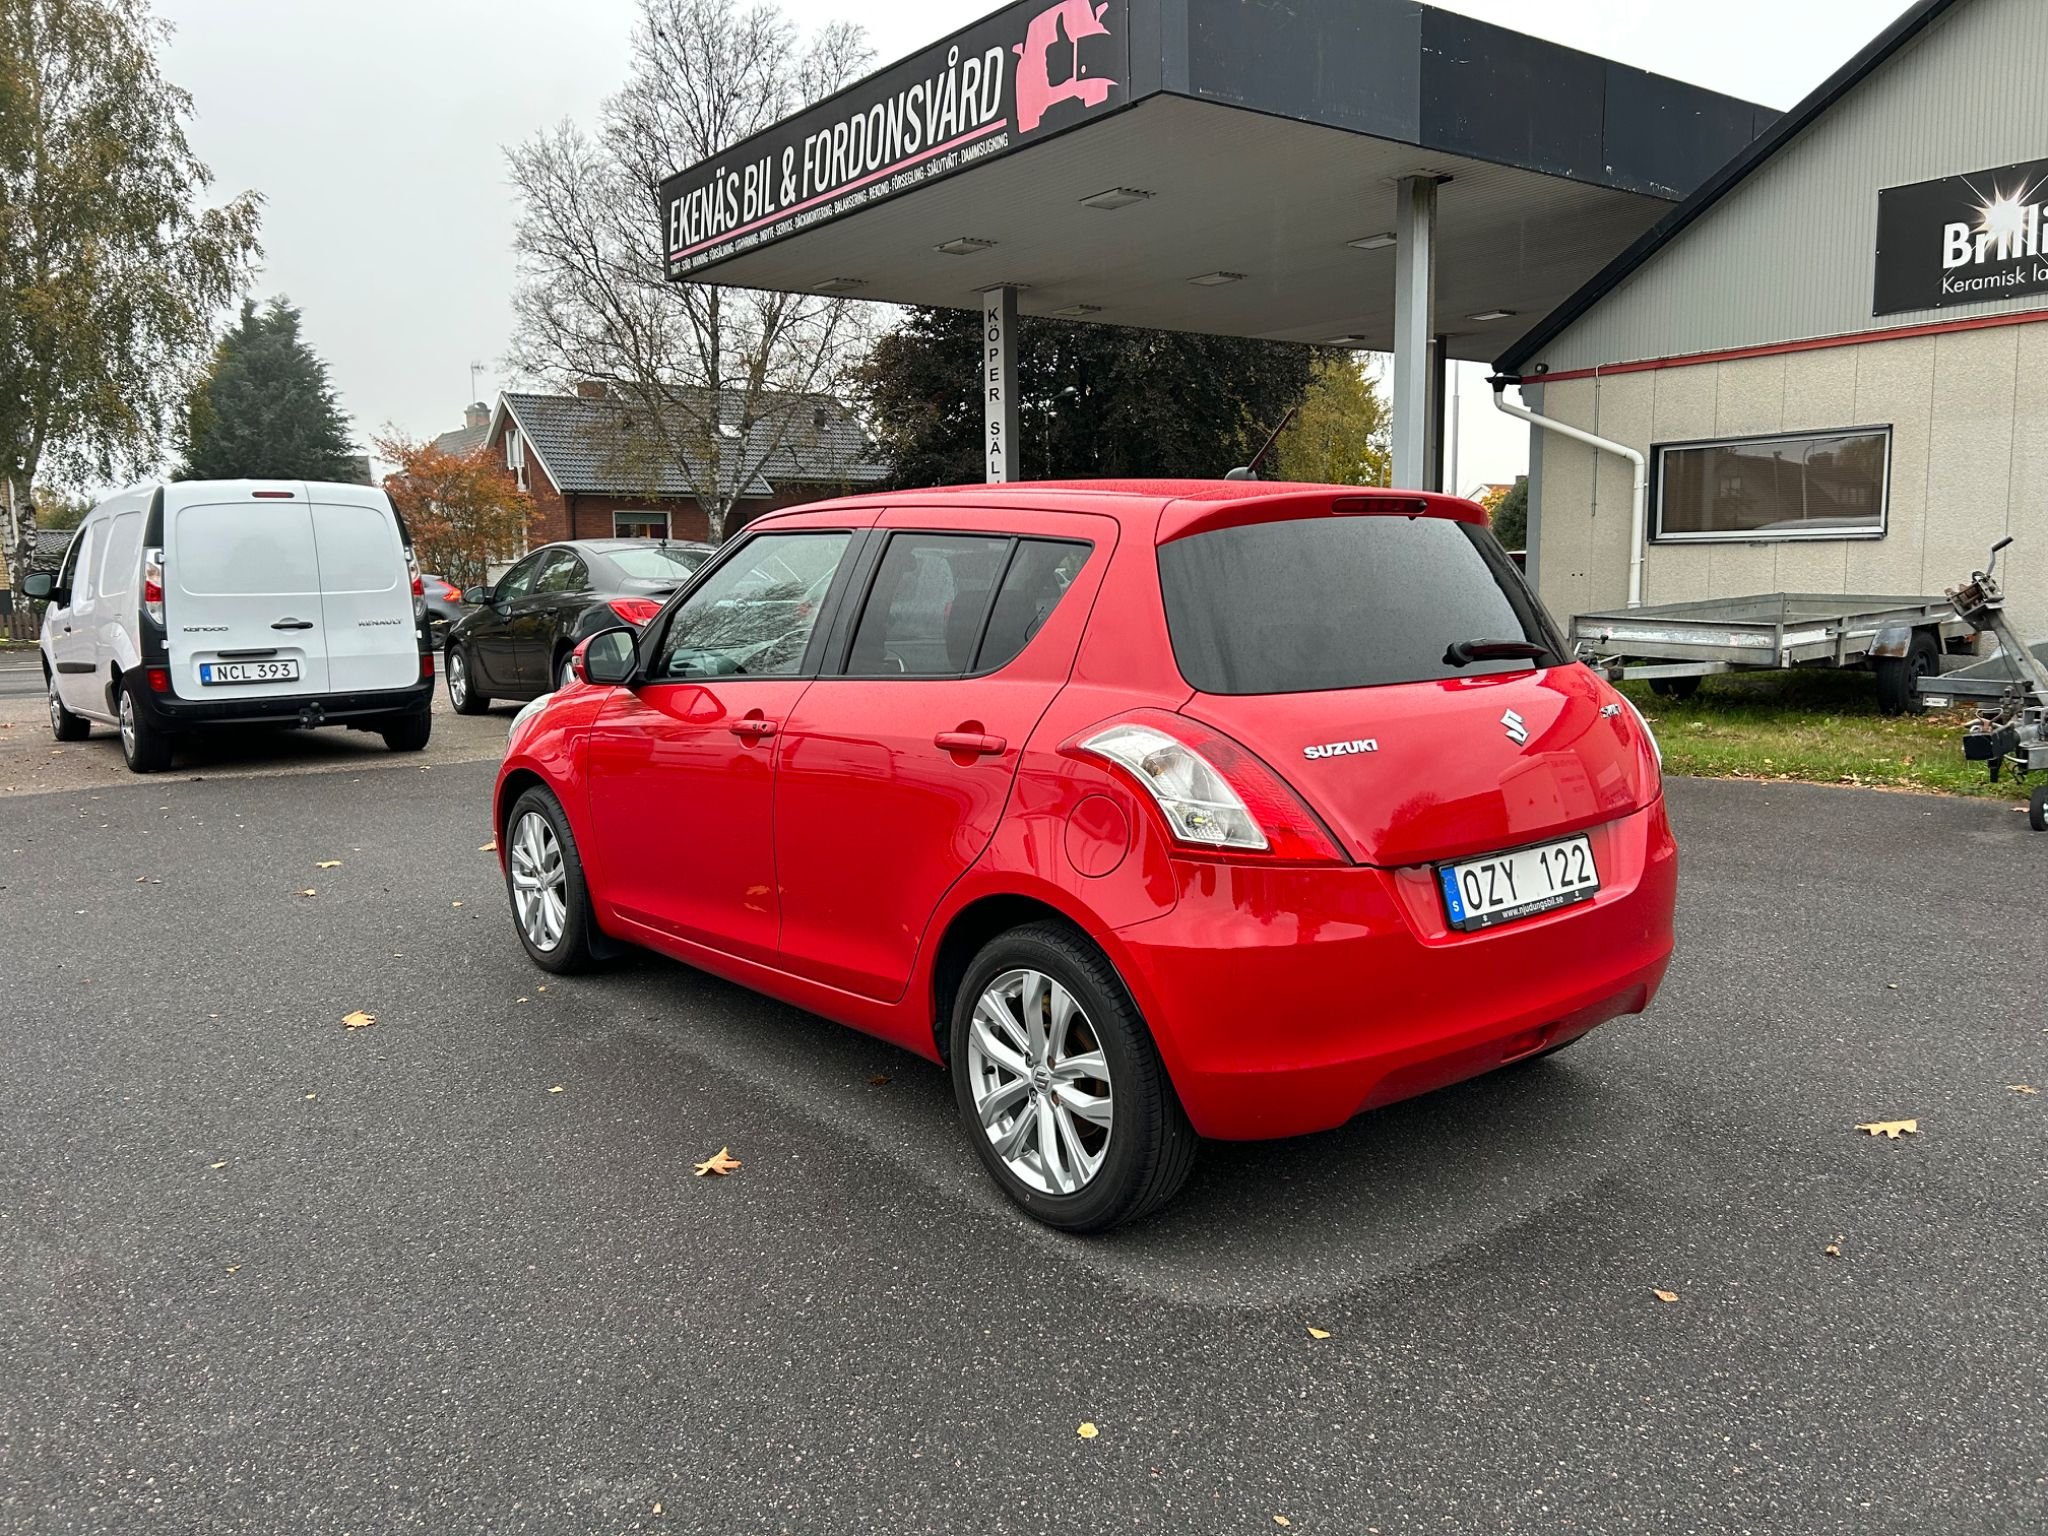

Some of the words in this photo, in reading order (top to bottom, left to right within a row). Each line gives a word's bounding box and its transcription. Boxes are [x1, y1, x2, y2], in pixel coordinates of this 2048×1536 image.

[669, 165, 740, 253] EKENÄS
[743, 155, 775, 223] BIL
[779, 145, 797, 207] &
[802, 45, 1005, 199] FORDONSVÅRD
[776, 218, 794, 236] SERVICE
[834, 190, 867, 213] BALANSERING
[869, 181, 889, 199] REKOND
[892, 166, 925, 191] FÖRSEGLING
[960, 132, 1009, 163] DAMMSUGNING
[1942, 265, 2026, 294] Keramisk
[987, 307, 1000, 402] KÖPER
[989, 421, 1001, 483] SÄL
[358, 618, 402, 626] RENAULT
[217, 665, 252, 681] NCL
[257, 663, 291, 679] 393
[1303, 738, 1379, 760] SUZUKI
[1463, 859, 1518, 911] OZY
[1539, 844, 1591, 890] 122
[1452, 901, 1460, 912] S
